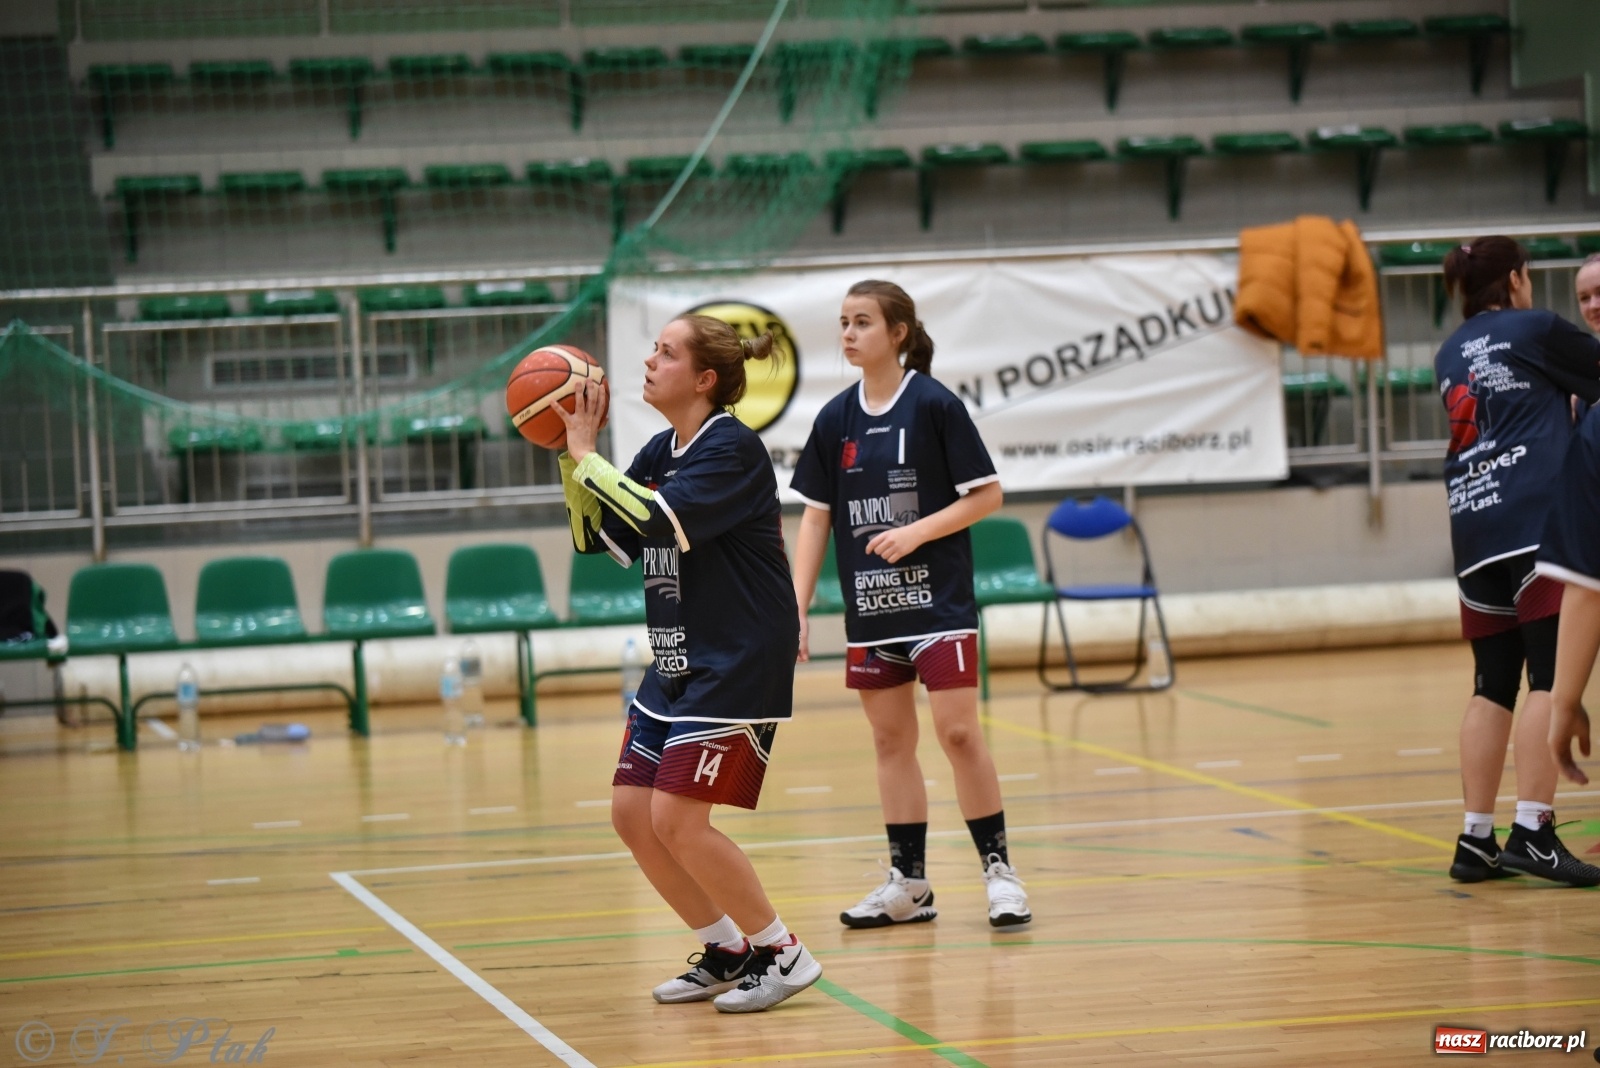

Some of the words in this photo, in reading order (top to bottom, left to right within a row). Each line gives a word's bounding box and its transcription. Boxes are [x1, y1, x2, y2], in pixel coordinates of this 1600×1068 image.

[1001, 428, 1253, 459] www.osir-raciborz.pl
[1468, 445, 1527, 478] LOVE?
[855, 572, 901, 590] GIVING
[904, 569, 930, 583] UP
[856, 589, 933, 612] SUCCEED
[694, 749, 724, 787] 14
